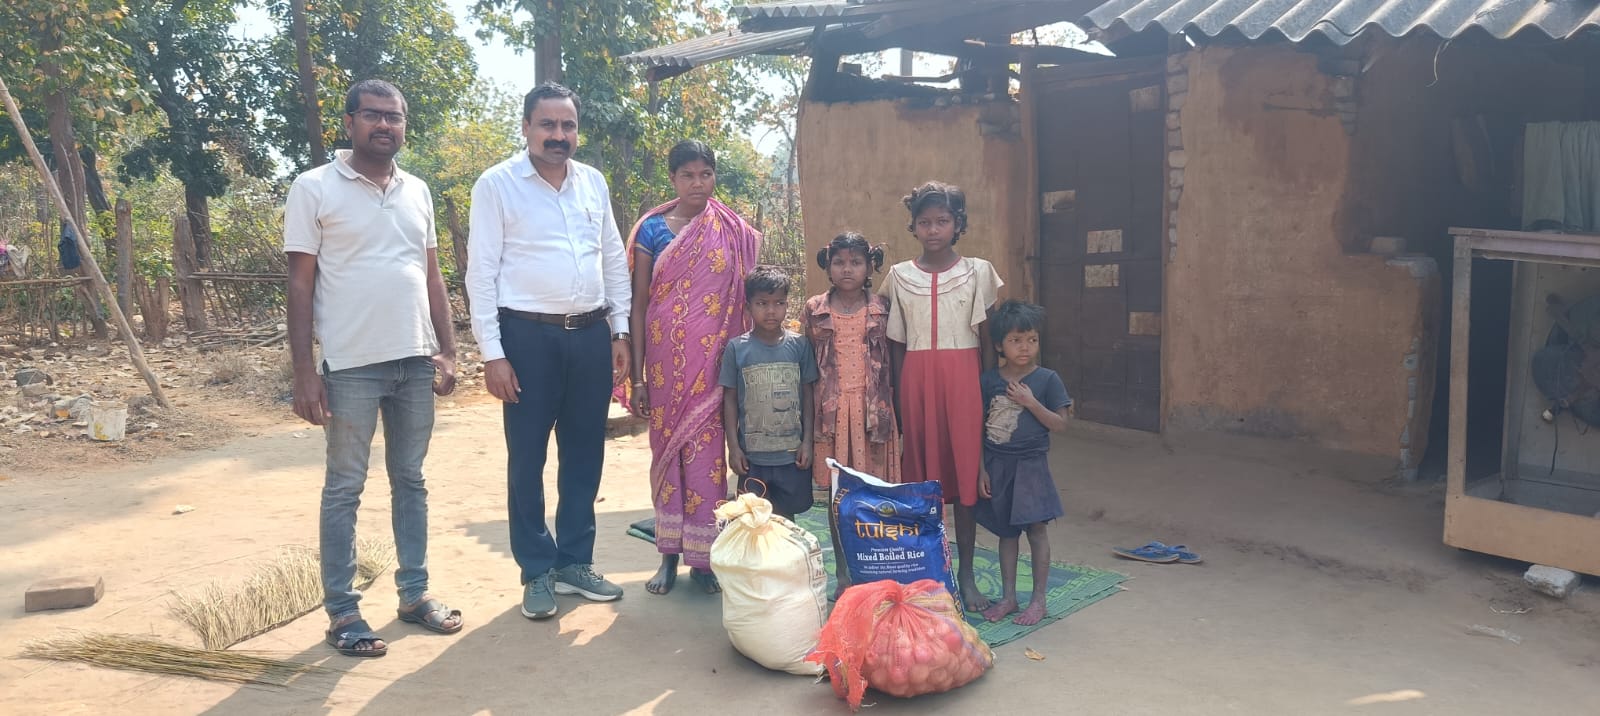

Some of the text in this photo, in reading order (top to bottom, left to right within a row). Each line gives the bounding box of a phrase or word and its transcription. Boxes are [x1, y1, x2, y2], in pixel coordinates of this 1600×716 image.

[855, 519, 920, 541] tulshi
[856, 550, 925, 561] Mixed Boiled Rice
